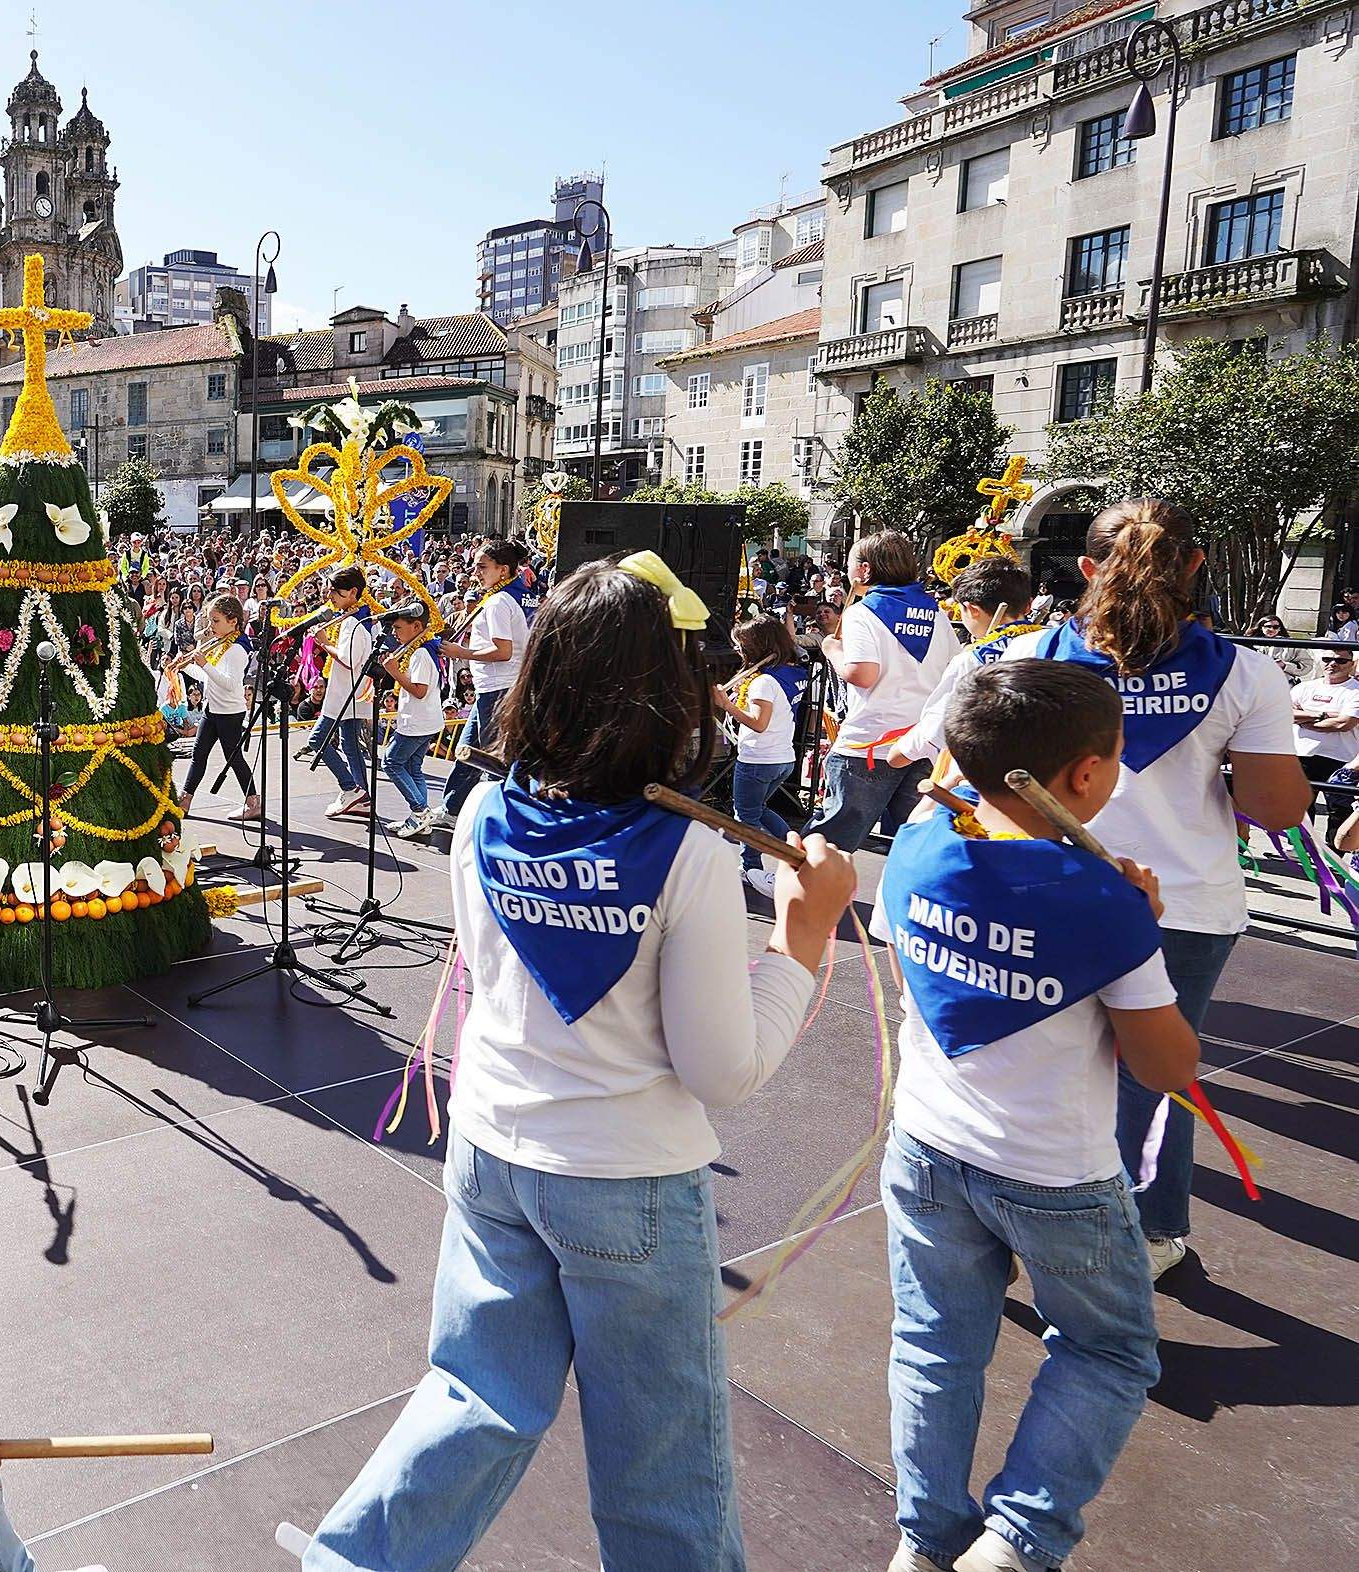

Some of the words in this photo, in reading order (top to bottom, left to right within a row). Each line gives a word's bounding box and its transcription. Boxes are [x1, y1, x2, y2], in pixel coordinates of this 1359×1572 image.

[906, 607, 934, 621] MAIO
[894, 622, 932, 637] FIGUE
[1104, 676, 1145, 693] AIO
[1152, 671, 1188, 692] DE
[1122, 693, 1210, 715] EIRIDO
[496, 859, 568, 889] MAIO
[573, 859, 620, 891] DE
[488, 888, 652, 935] IGUEIRIDO
[907, 893, 978, 943] MAIO
[988, 922, 1035, 958] DE
[896, 924, 1064, 1006] FIGUEIRIDO
